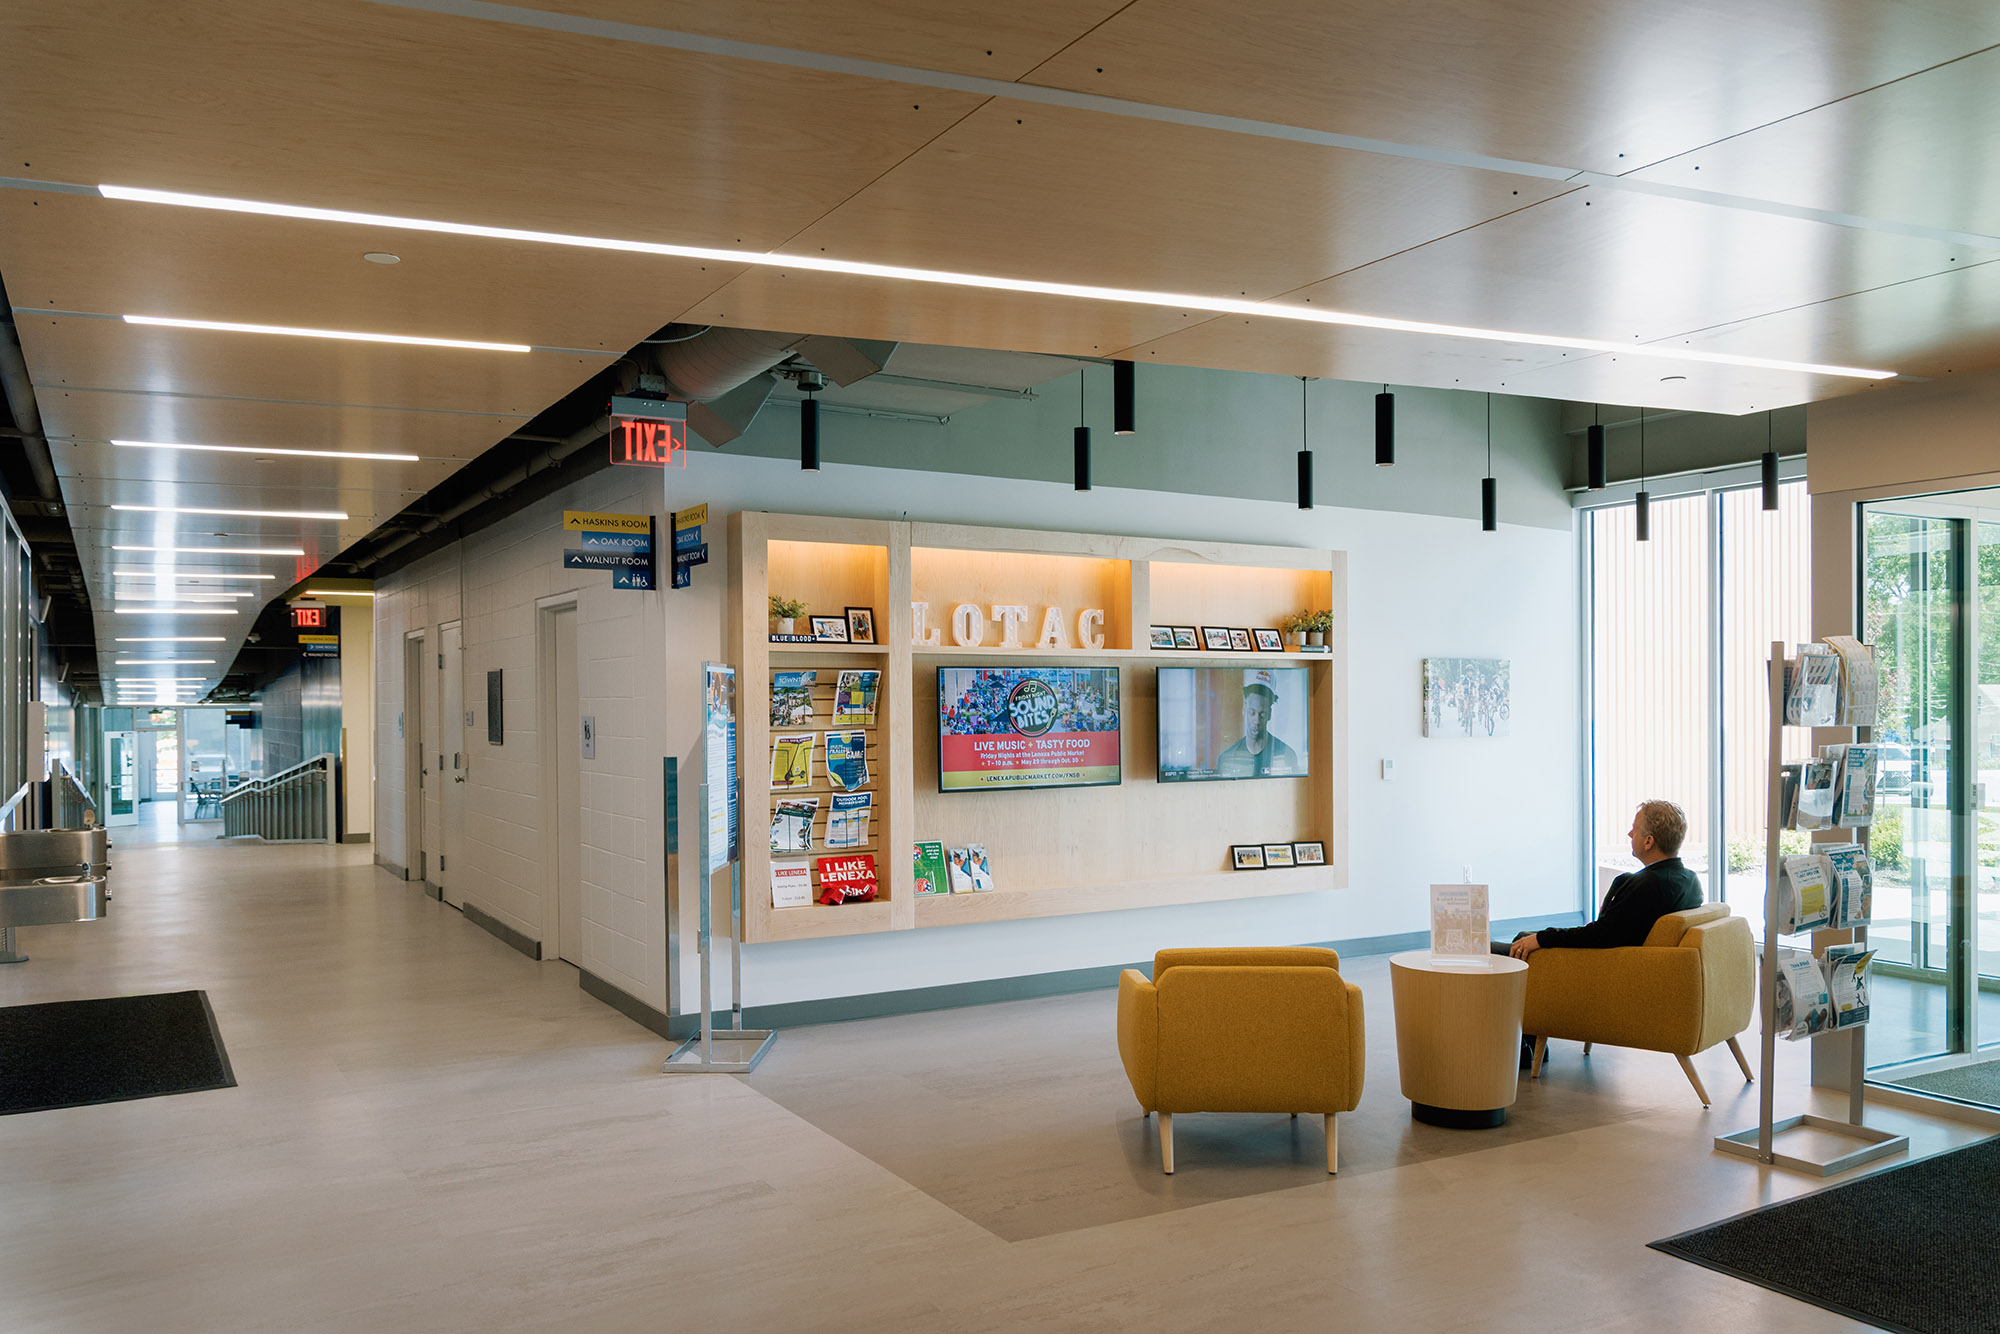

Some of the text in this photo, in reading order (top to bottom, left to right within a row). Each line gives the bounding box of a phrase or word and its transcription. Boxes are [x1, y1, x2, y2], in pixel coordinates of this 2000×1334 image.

[582, 518, 648, 529] HASKINS ROOM
[601, 537, 648, 547] OAK ROOM
[684, 533, 695, 542] ROOM
[584, 556, 649, 566] WALNUT ROOM
[690, 551, 701, 561] ROOM
[911, 601, 1105, 650] LOTAC
[1015, 690, 1046, 701] FRIDAY NIGHT
[1009, 695, 1056, 717] SOUND
[1017, 710, 1050, 729] BITES
[974, 739, 1091, 751] LIVE MUSIC TASTY FOOD
[826, 860, 866, 871] I LIKE
[820, 869, 875, 882] LENEXA
